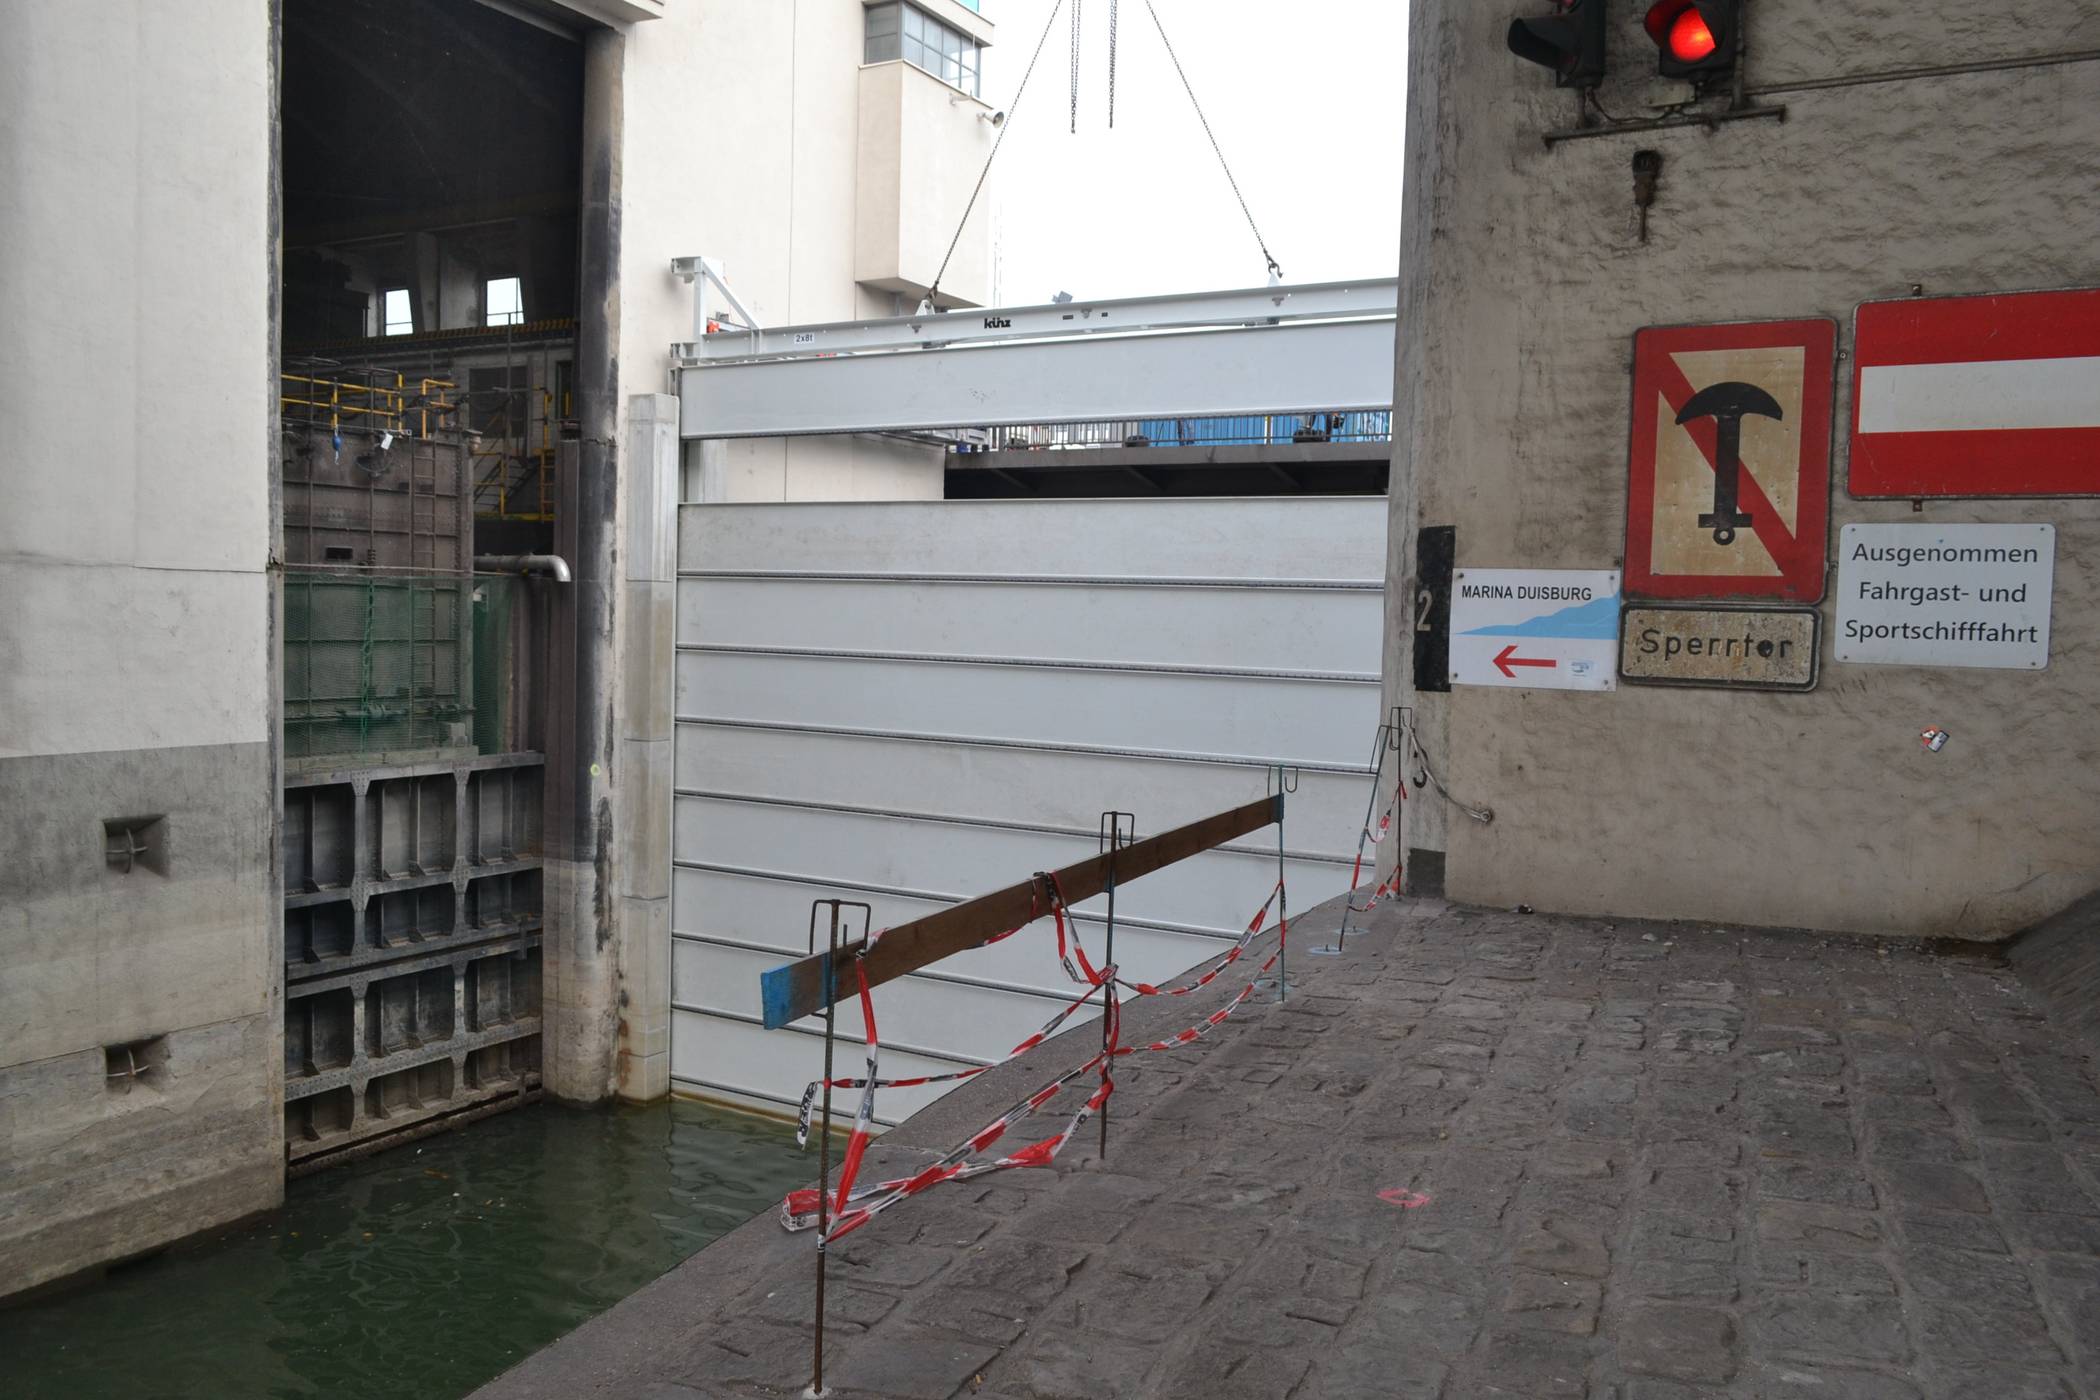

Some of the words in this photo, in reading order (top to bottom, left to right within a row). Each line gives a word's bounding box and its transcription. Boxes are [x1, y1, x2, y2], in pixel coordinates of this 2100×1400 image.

[1852, 543, 2038, 567] Ausgenommen
[1461, 585, 1513, 599] MARINA
[1517, 586, 1592, 601] DUISBURG
[1859, 581, 1970, 606] Fahrgast-
[1979, 583, 2027, 603] und
[1416, 589, 1433, 632] 2
[1845, 619, 2038, 643] Sportschifffahrt
[1639, 628, 1793, 661] Sperrtor
